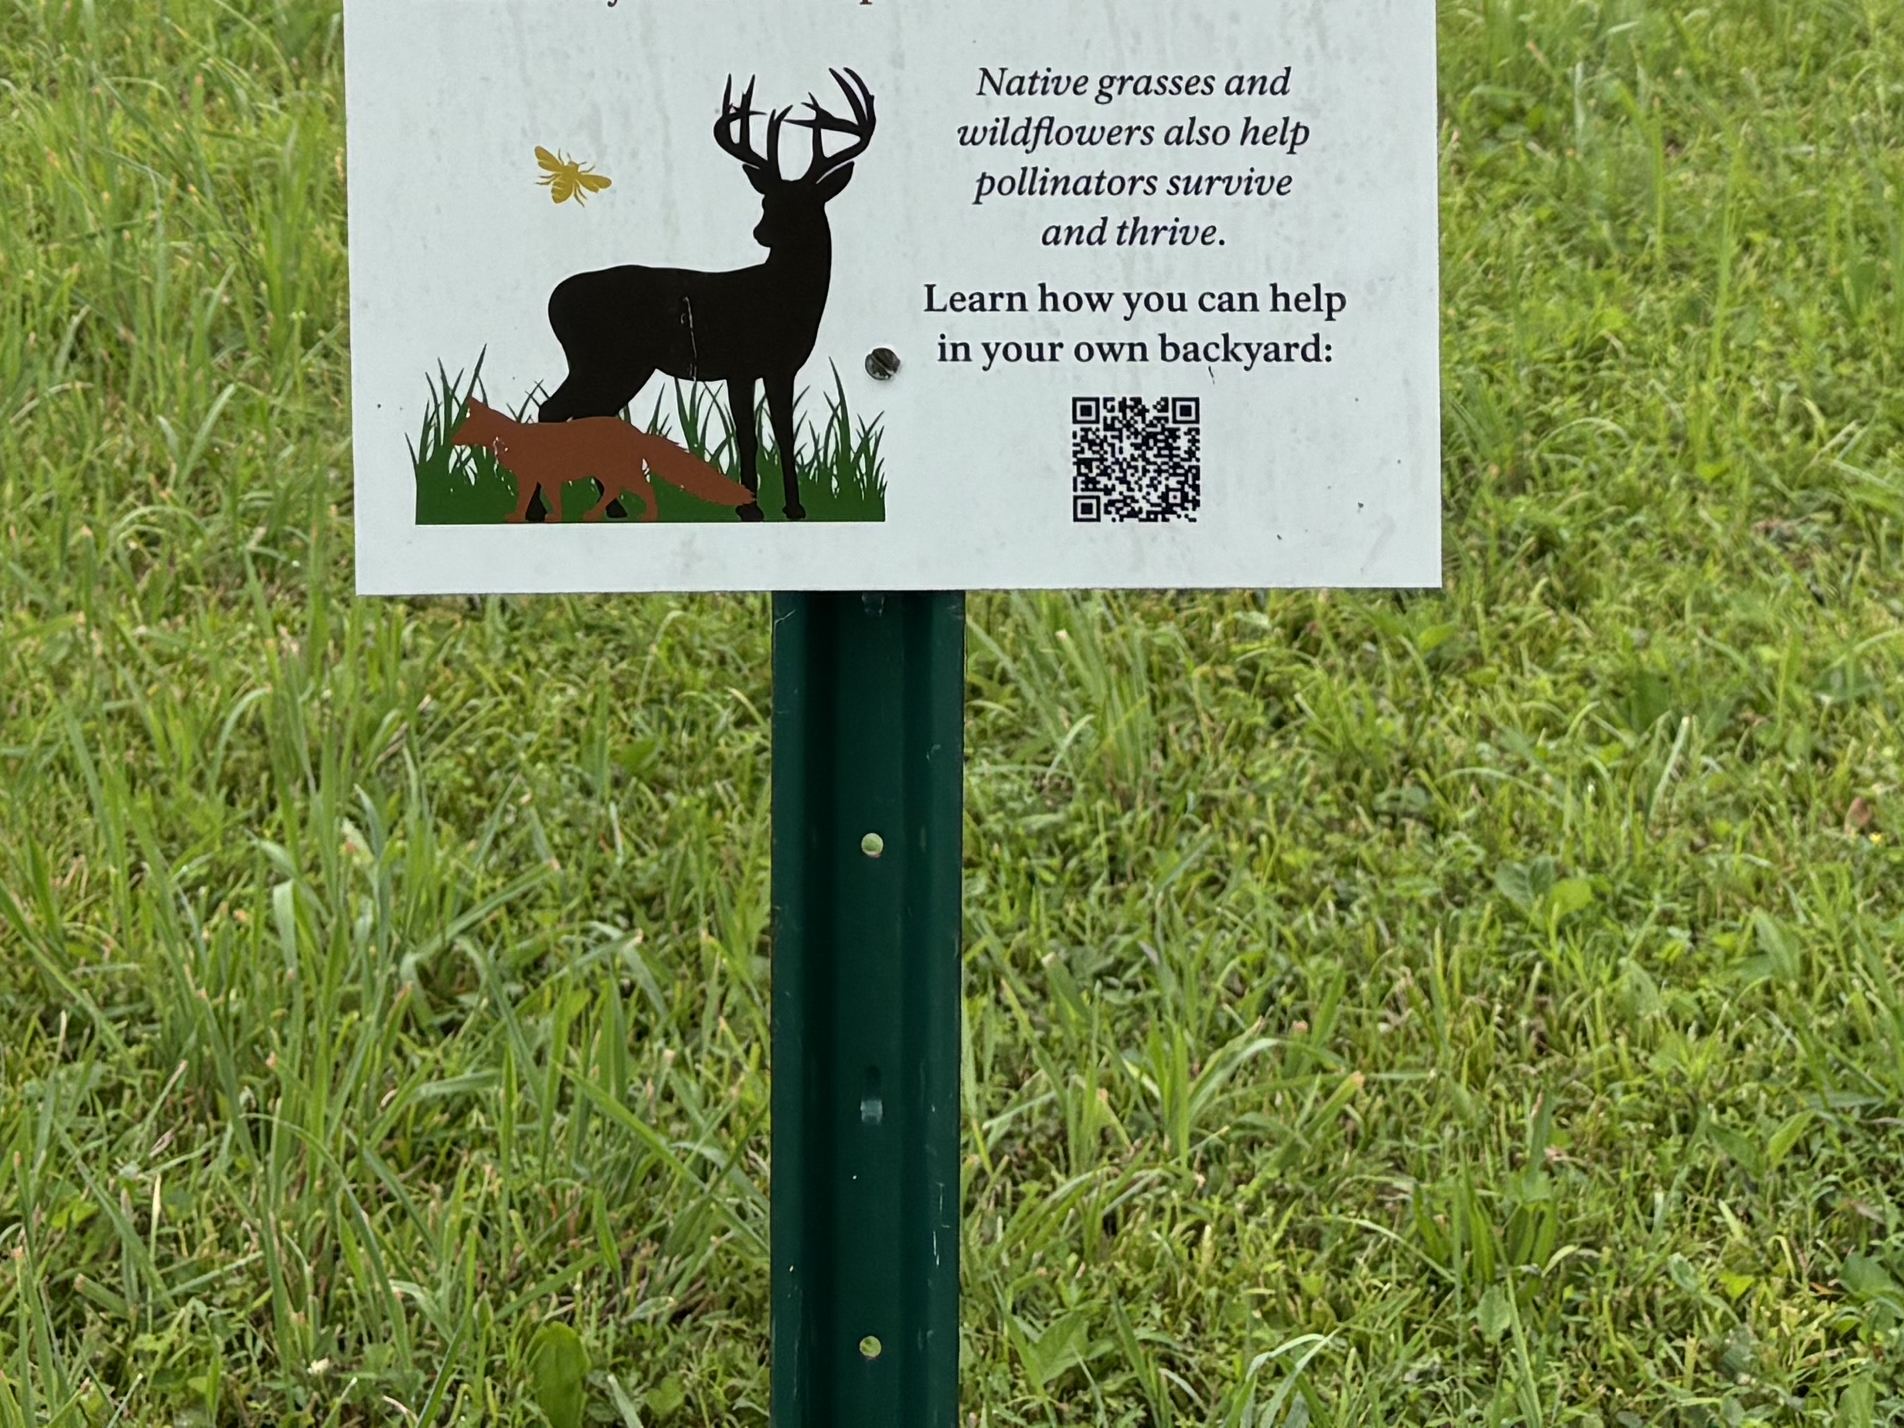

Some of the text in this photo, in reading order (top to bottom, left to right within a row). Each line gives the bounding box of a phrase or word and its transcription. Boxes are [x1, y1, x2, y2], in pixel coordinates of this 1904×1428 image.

[976, 65, 1292, 105] Native grasses and
[957, 115, 1310, 155] wildflowers also help
[972, 165, 1293, 206] pollinators survive
[1041, 215, 1225, 246] and thrive.
[923, 282, 1347, 322] Learn how you can help
[937, 332, 1332, 373] in your own backyard:
